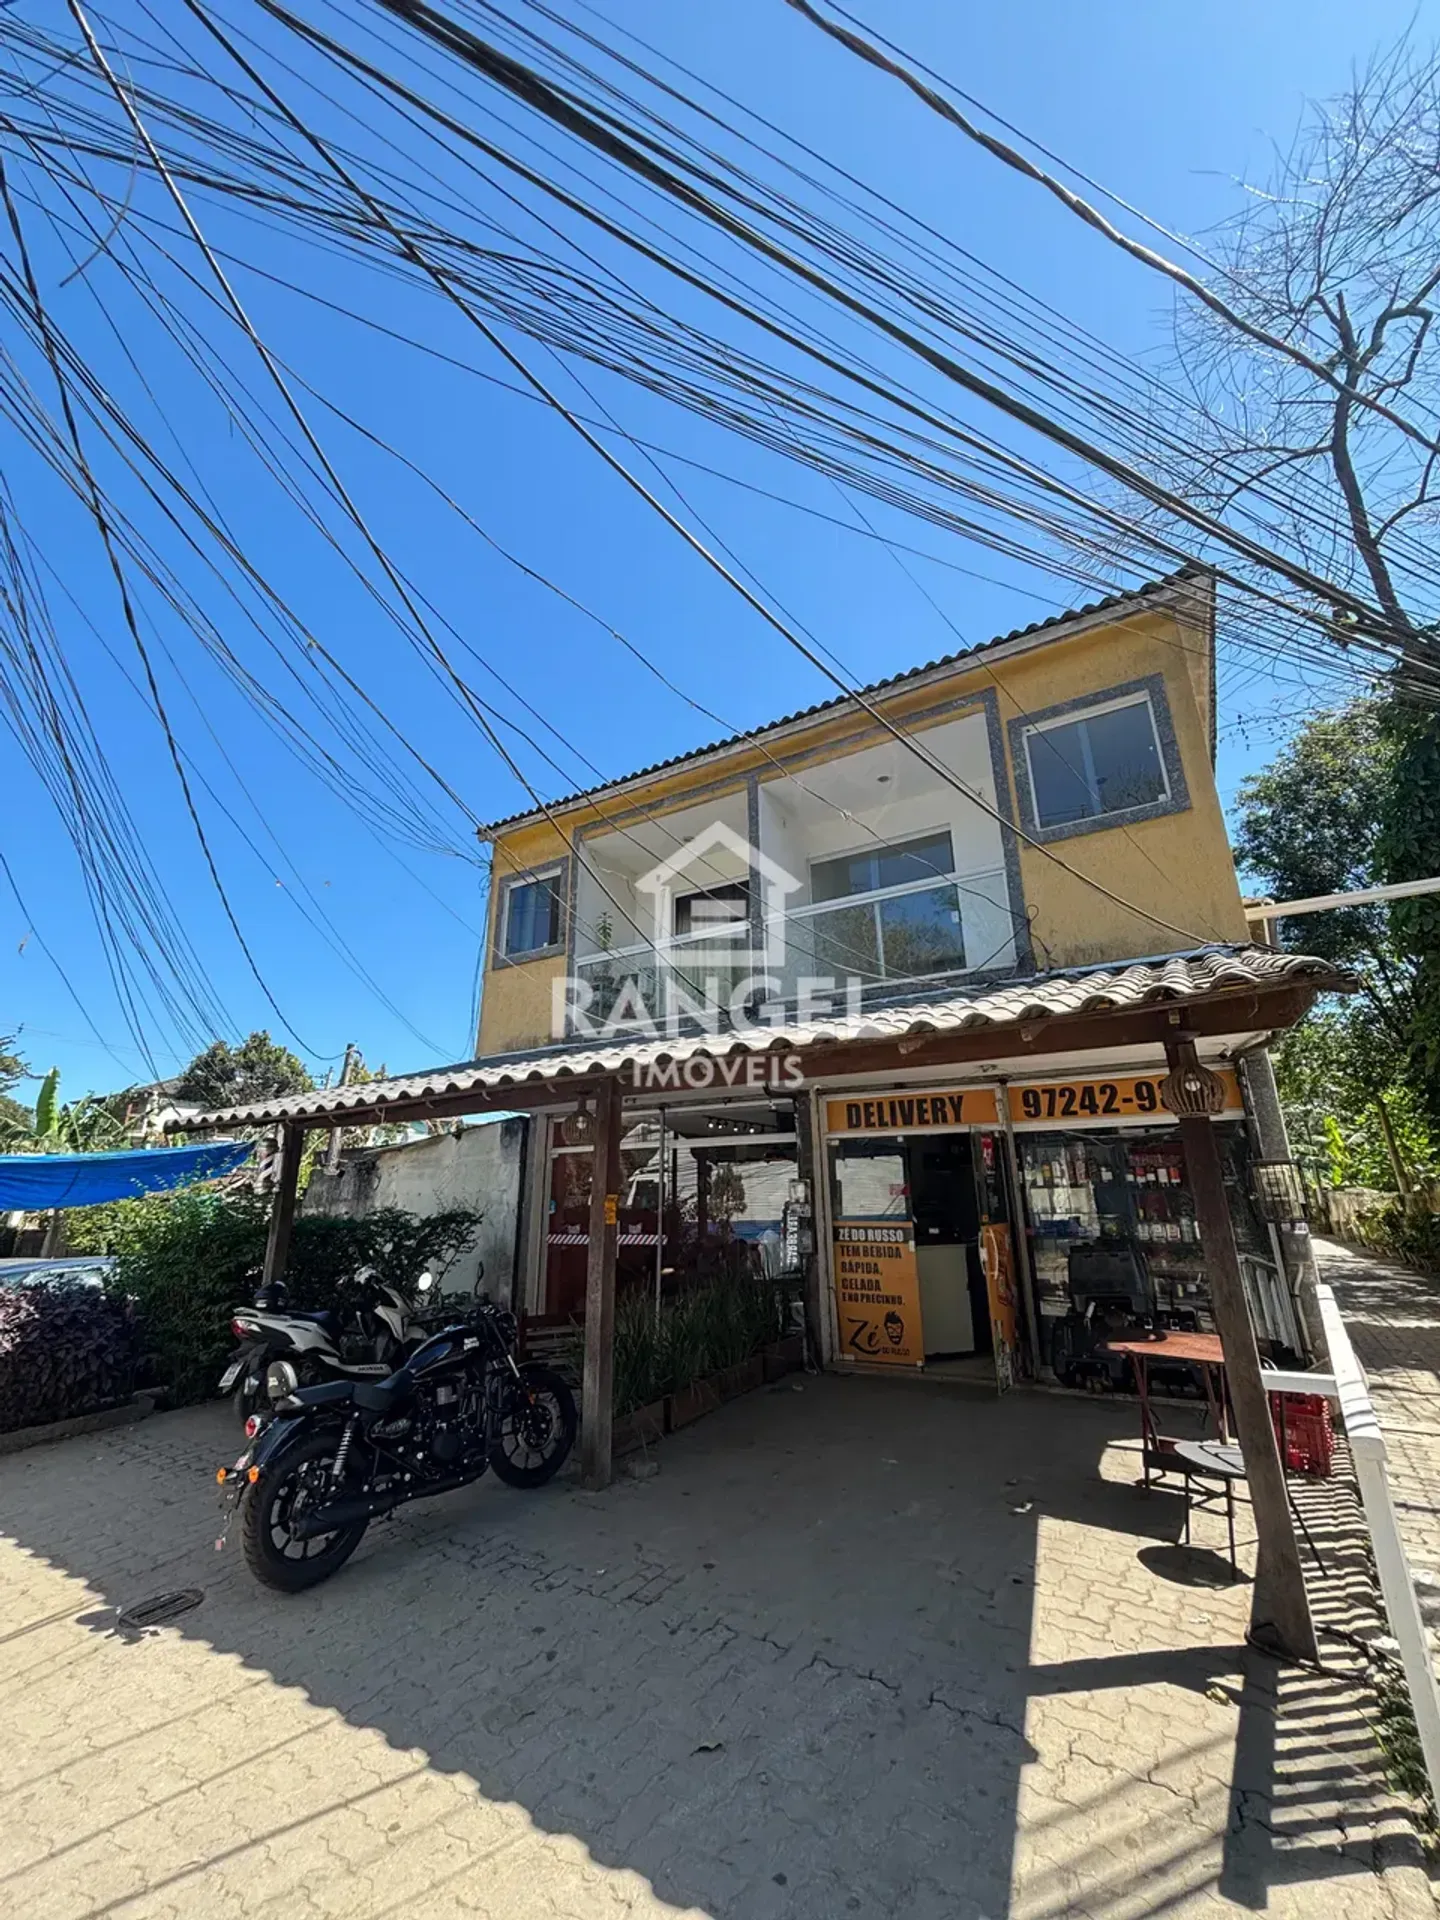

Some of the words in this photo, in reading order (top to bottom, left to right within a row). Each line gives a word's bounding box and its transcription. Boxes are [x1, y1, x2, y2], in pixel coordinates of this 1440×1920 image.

[1022, 1078, 1169, 1119] 97242-9
[846, 1094, 965, 1129] DELIVERY
[838, 1227, 850, 1241] ZÉ
[851, 1228, 867, 1242] DO
[867, 1228, 904, 1242] RUSSO
[840, 1245, 861, 1258] TEM
[862, 1245, 902, 1259] BEBIDA
[841, 1277, 882, 1292] GELADA
[848, 1292, 859, 1303] NO
[847, 1318, 881, 1354] Zé
